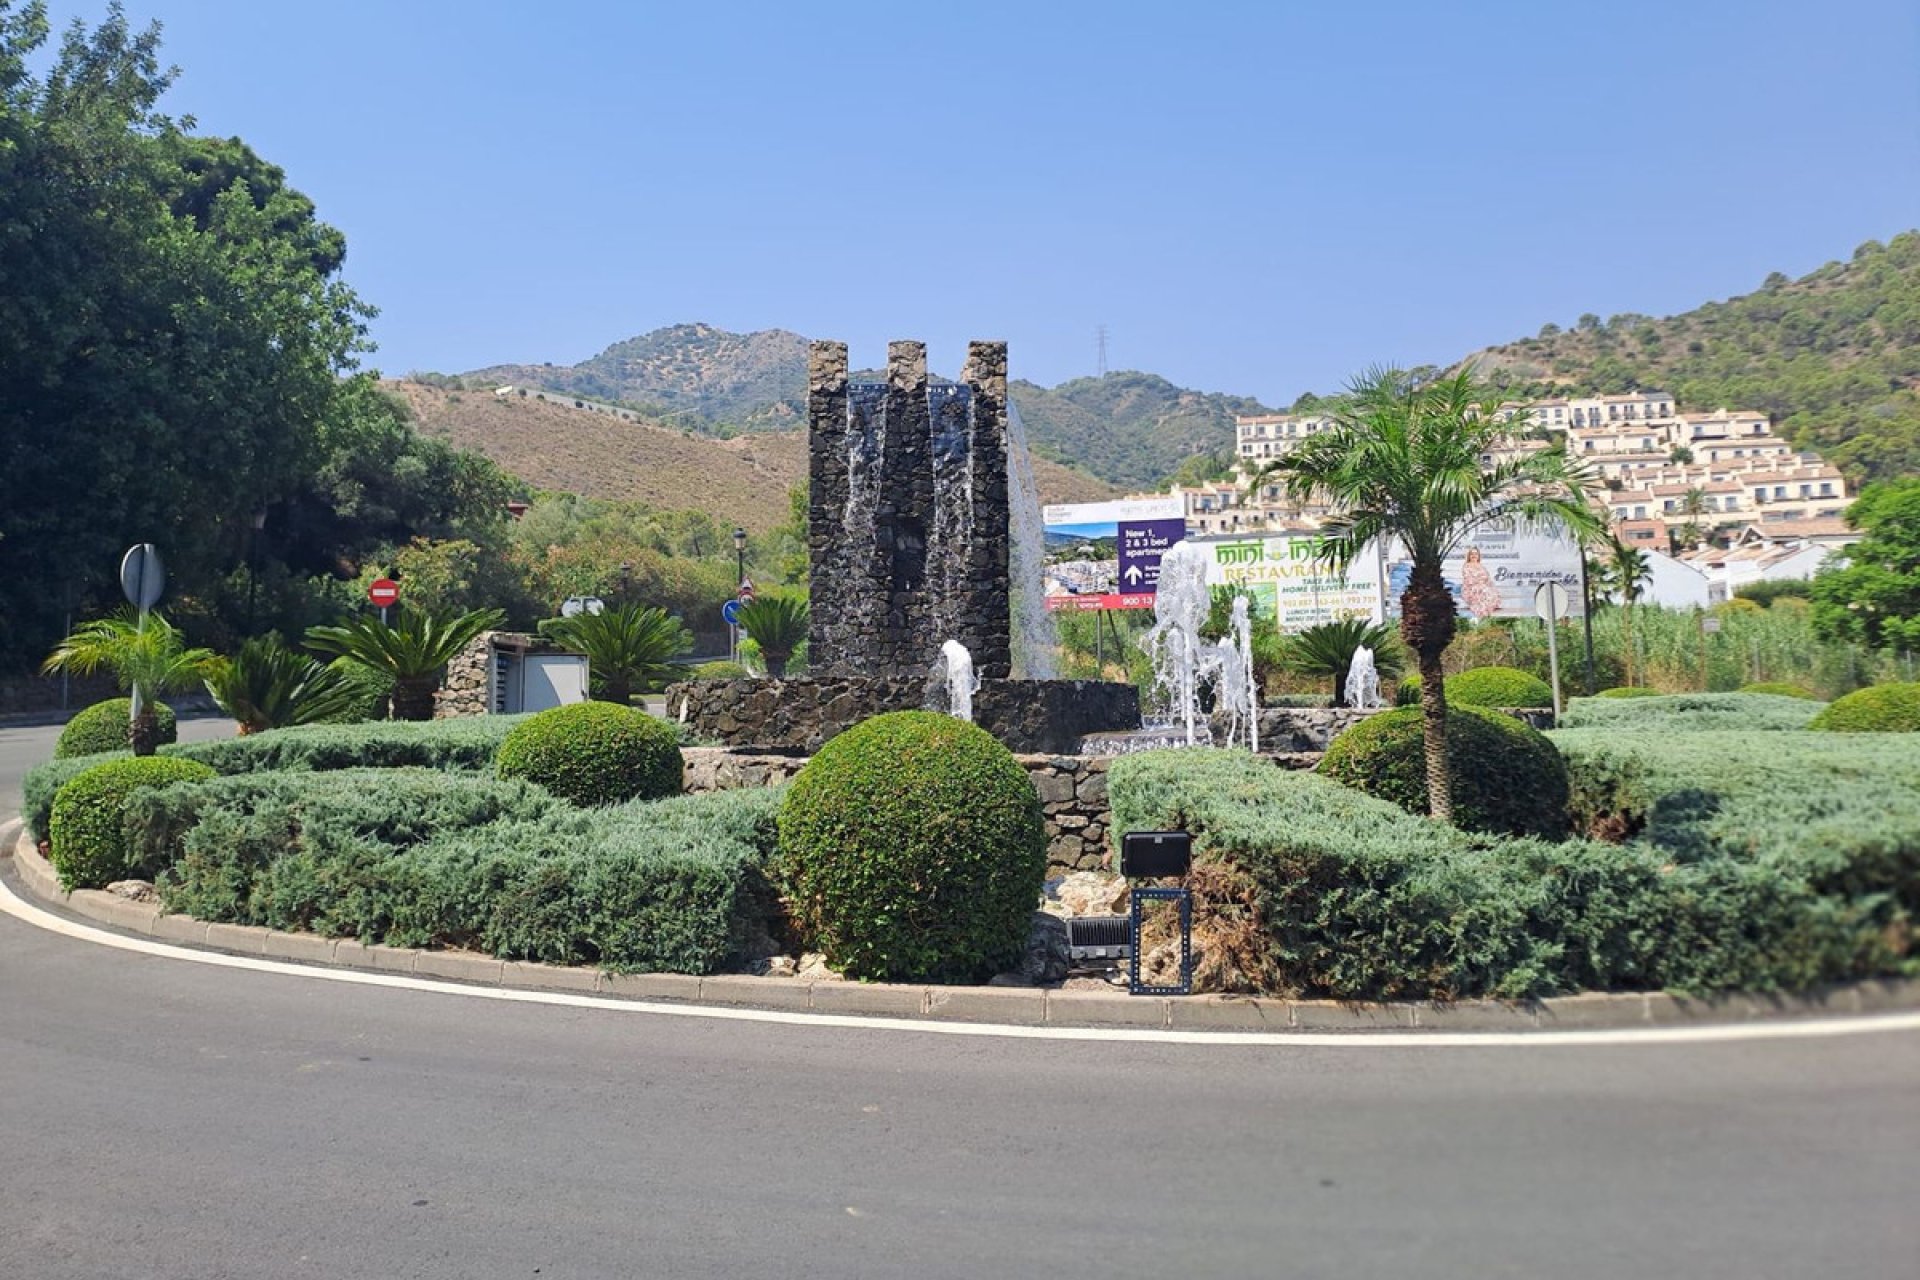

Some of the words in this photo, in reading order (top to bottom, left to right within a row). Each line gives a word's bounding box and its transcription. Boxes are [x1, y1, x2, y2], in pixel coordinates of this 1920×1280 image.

[1126, 529, 1145, 539] New
[1125, 538, 1132, 547] 2
[1133, 539, 1141, 547] &
[1143, 538, 1149, 547] 3
[1150, 537, 1169, 547] bed
[1125, 547, 1167, 558] apartme
[1215, 538, 1265, 566] mini
[1282, 585, 1308, 593] HOME
